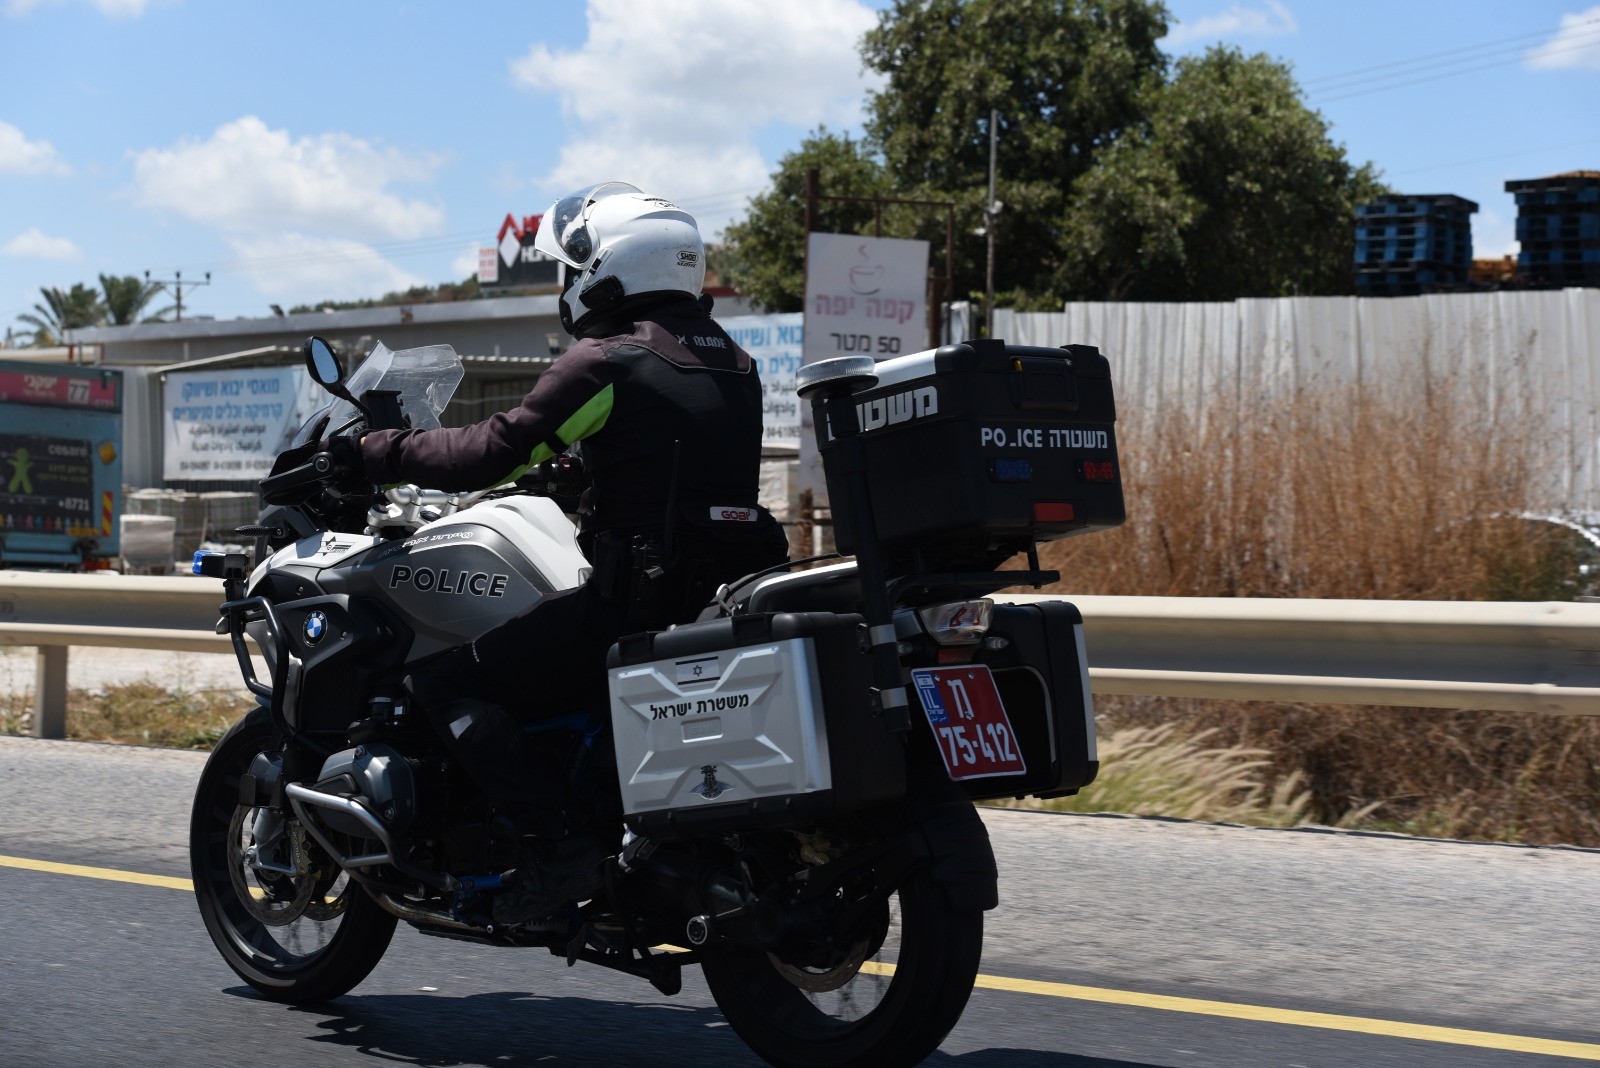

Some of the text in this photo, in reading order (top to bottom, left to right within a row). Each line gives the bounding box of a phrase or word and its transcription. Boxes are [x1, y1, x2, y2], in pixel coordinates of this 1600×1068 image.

[815, 294, 916, 324] קפה יפה
[726, 323, 803, 347] בוא ושיוו
[830, 333, 901, 354] 50 מטר
[69, 383, 90, 401] 77
[221, 379, 244, 397] יבוא
[215, 401, 242, 420] וכלים
[244, 403, 283, 423] קרמיקה
[827, 386, 938, 441] משט
[1049, 428, 1108, 449] משטרה
[389, 564, 509, 599] POLICE
[650, 694, 749, 721] משטרת ישראל
[923, 689, 940, 709] IL
[939, 722, 1017, 767] 75-412
